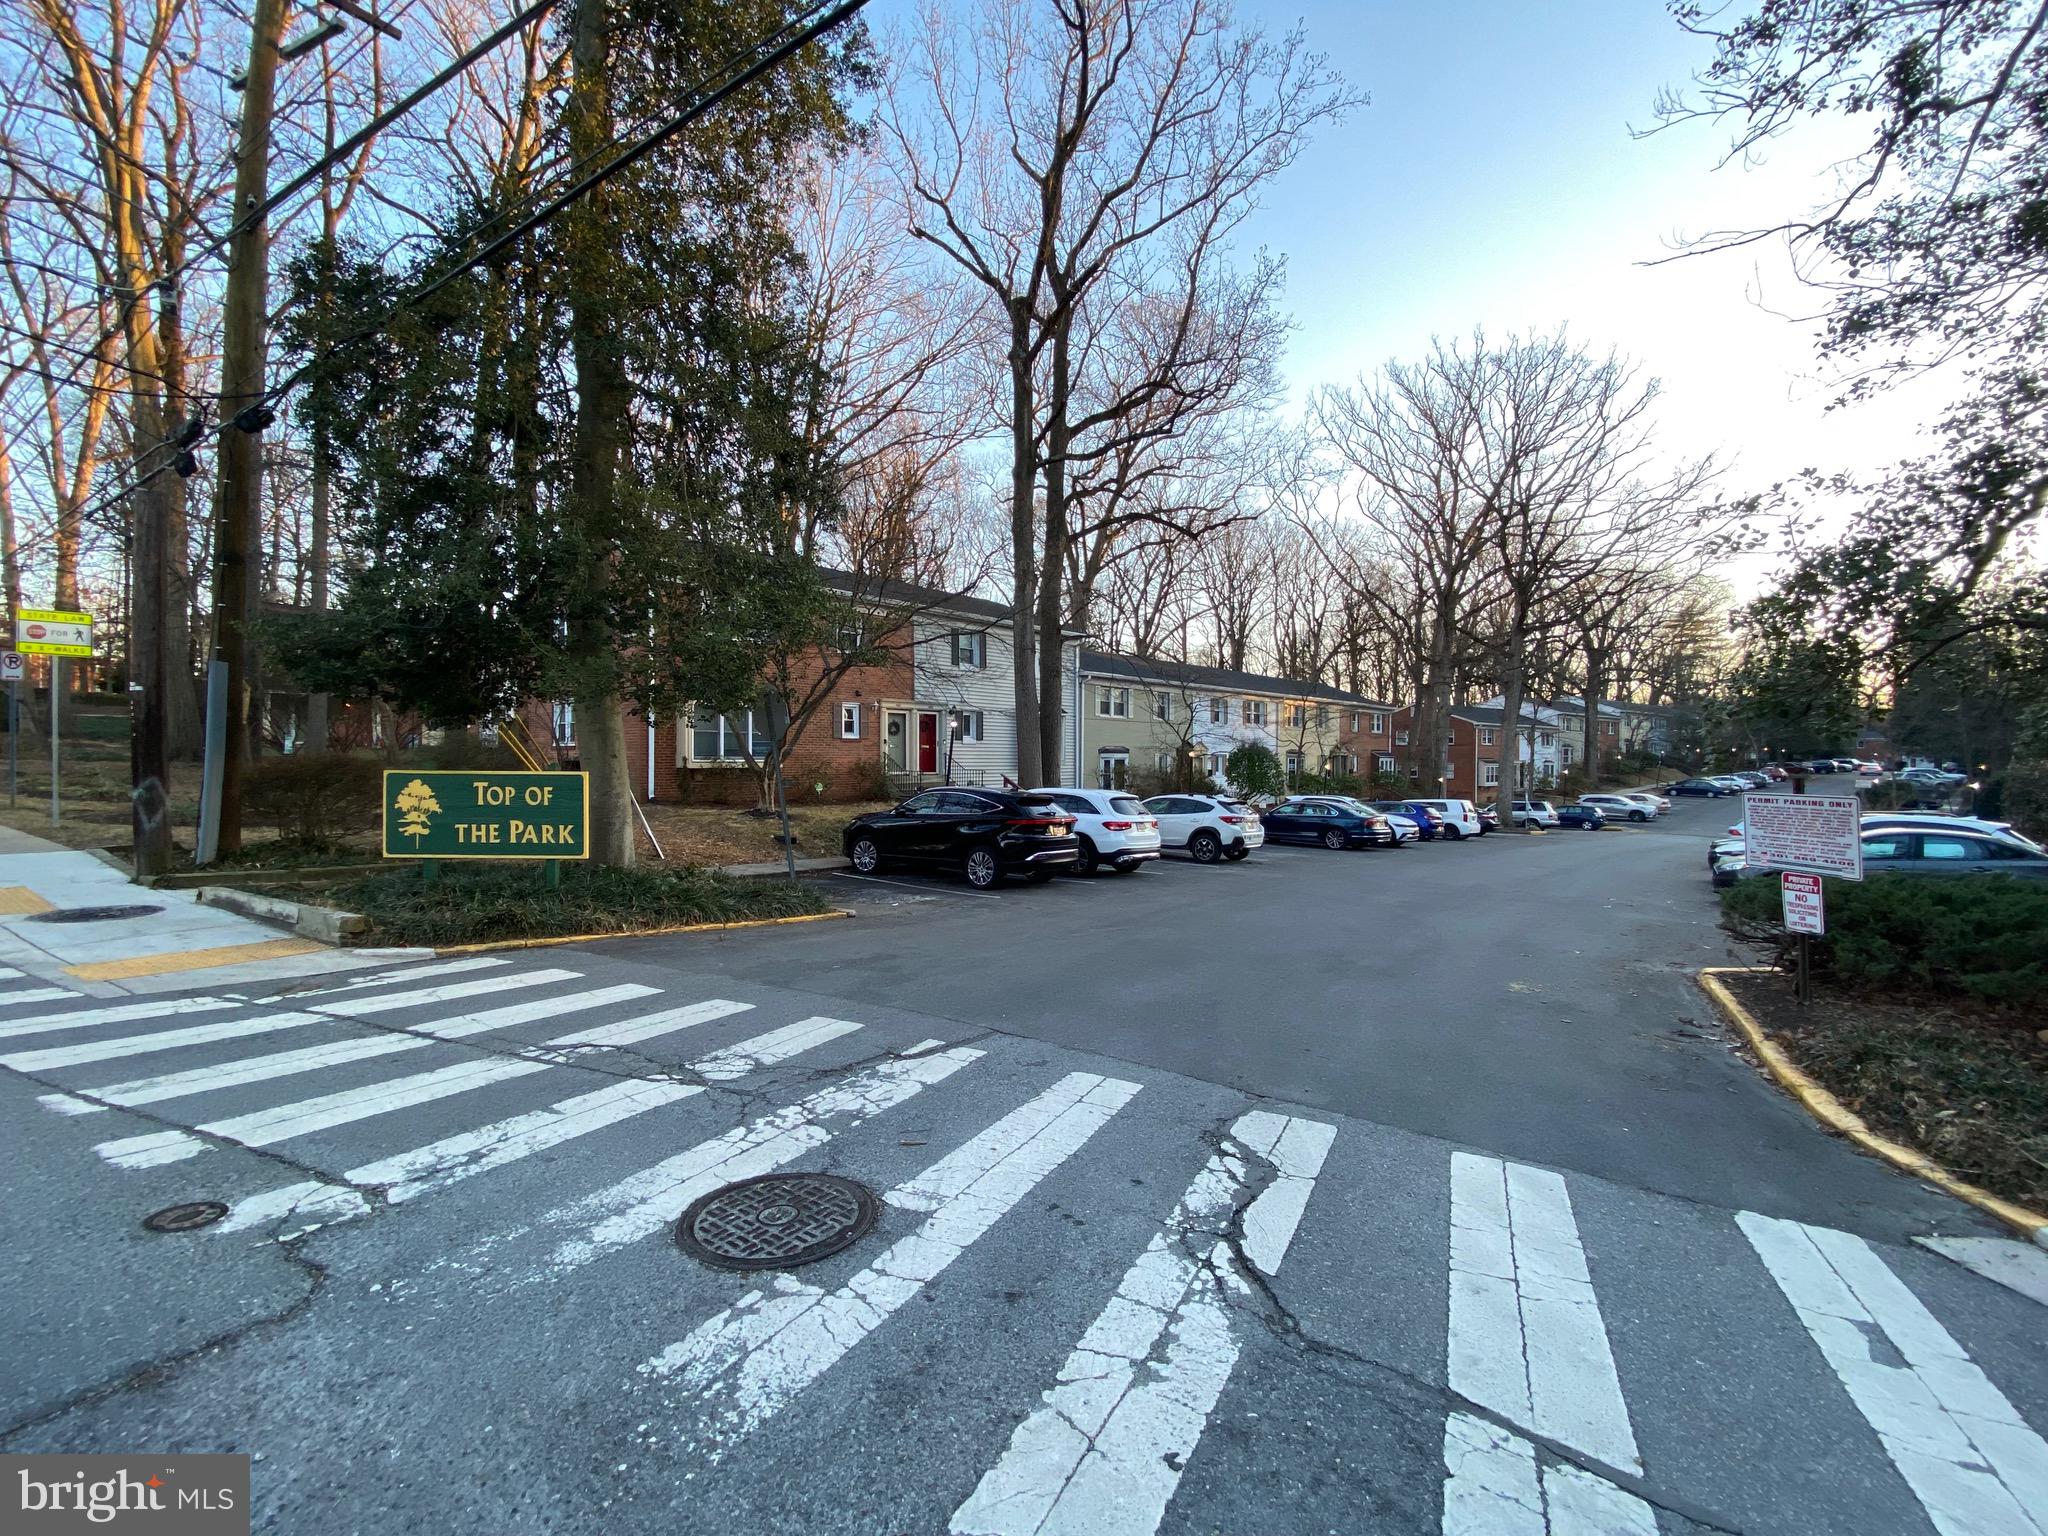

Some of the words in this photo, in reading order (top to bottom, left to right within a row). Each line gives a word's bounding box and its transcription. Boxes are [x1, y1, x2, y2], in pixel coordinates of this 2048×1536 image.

[27, 612, 57, 620] STATE
[473, 781, 516, 806] TOP
[524, 786, 553, 806] OF
[1747, 797, 1780, 805] PERMIT
[1783, 799, 1825, 807] PARKING
[454, 823, 501, 844] THE
[509, 820, 575, 844] PARK
[1788, 876, 1814, 885] PRIVATE
[1784, 882, 1819, 893] PROPERTY
[1794, 894, 1808, 903] NO
